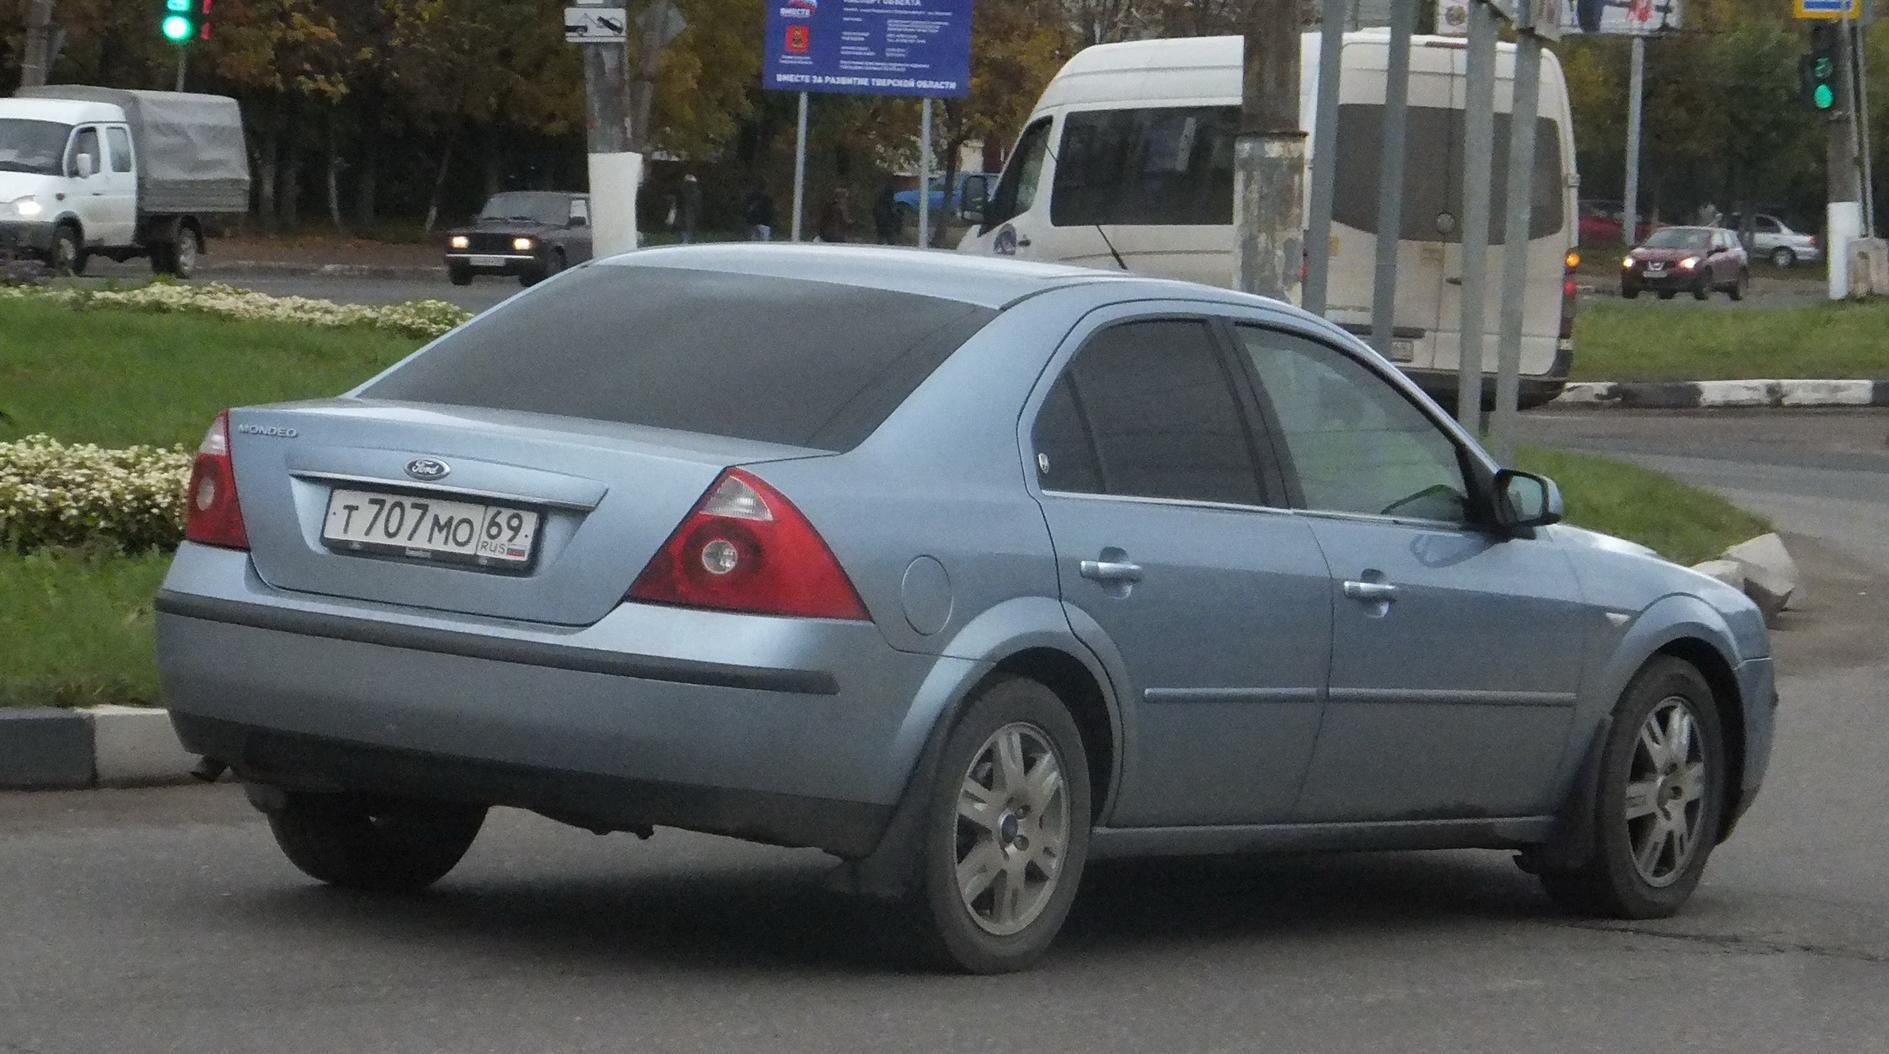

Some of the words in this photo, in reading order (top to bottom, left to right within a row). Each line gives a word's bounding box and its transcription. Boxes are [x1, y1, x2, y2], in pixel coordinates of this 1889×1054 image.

[776, 74, 810, 83] ВМЕСТЕ
[812, 76, 823, 84] ЗА
[825, 77, 870, 86] РАЗВИТИЕ
[871, 78, 915, 88] ТВЕРСКОЙ
[916, 81, 957, 90] ОБЛАСТИ
[238, 424, 298, 438] MONDEO
[411, 459, 440, 475] Ford
[485, 510, 523, 543] 69
[480, 540, 505, 554] RUS
